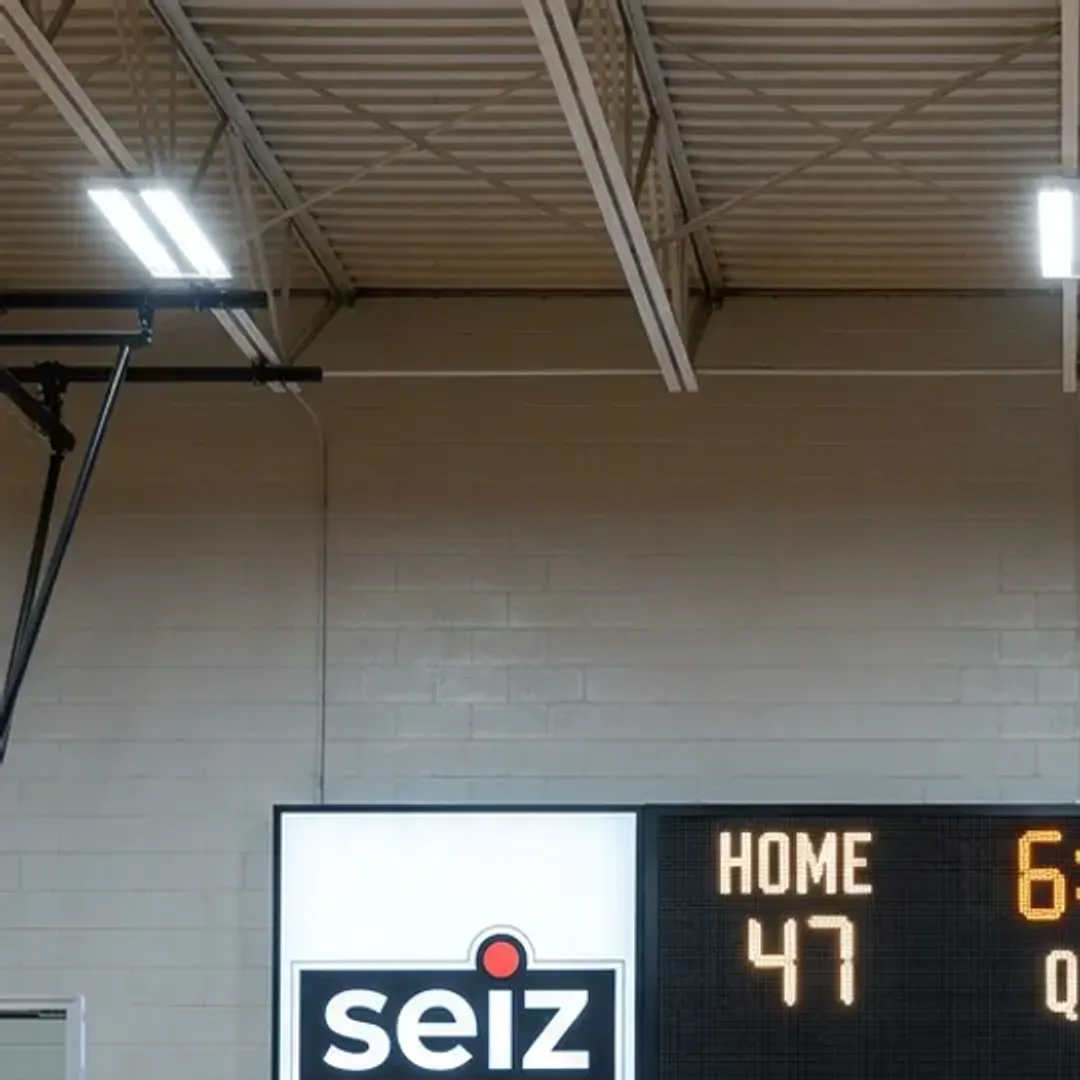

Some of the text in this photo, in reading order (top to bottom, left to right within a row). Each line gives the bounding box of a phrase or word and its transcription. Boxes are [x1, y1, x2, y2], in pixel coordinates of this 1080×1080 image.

[719, 831, 873, 895] HOME
[322, 941, 590, 1071] seiz
[747, 914, 856, 1007] 47
